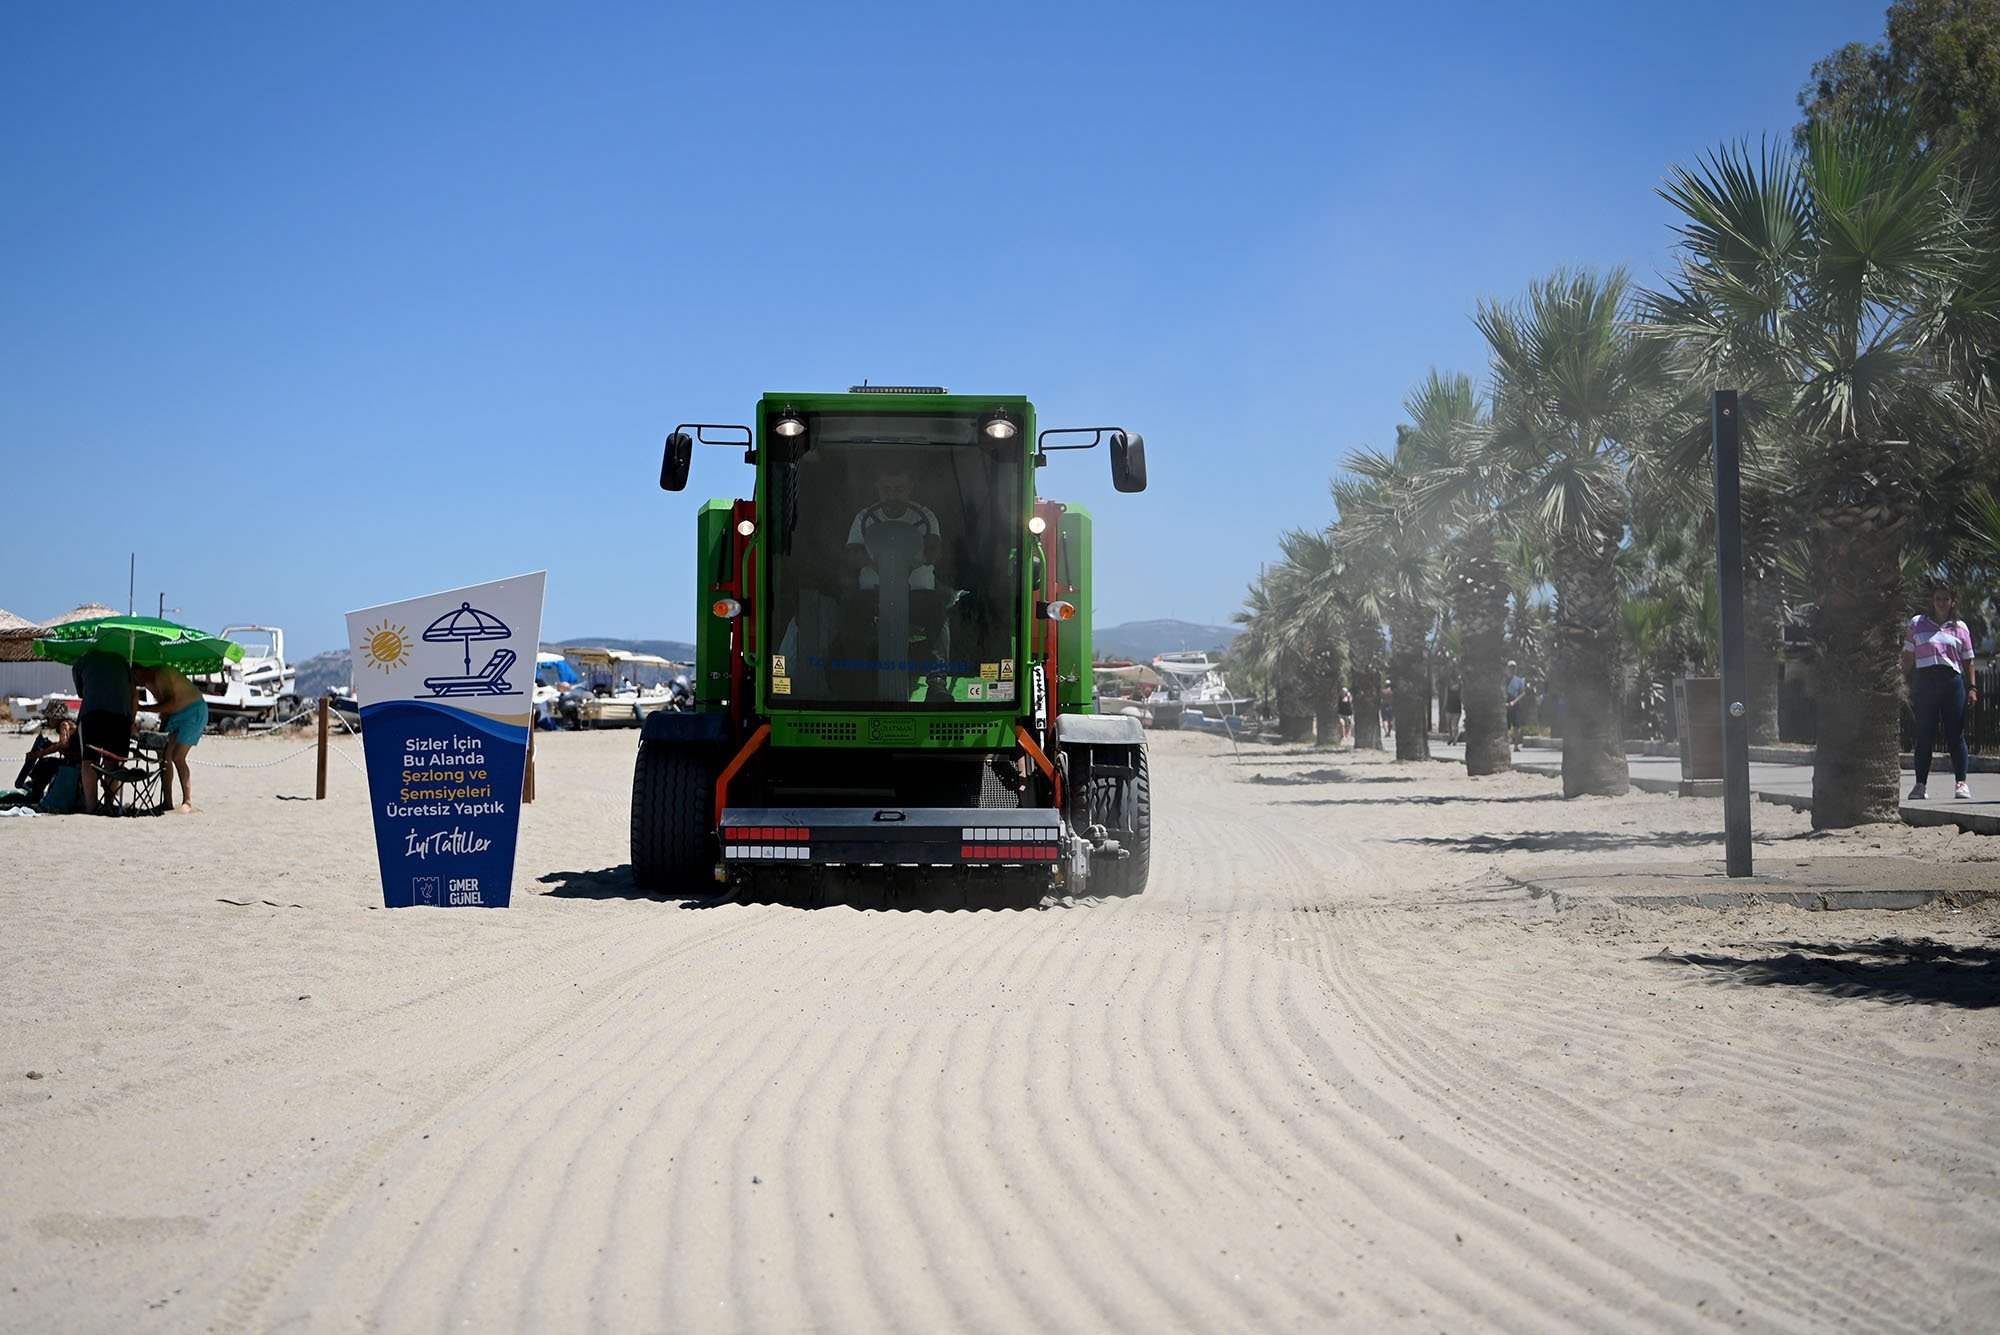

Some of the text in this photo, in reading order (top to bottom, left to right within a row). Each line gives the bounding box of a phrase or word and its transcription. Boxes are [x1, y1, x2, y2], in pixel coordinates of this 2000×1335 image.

[405, 733, 482, 753] Sizler İçin
[403, 751, 485, 767] Bu Alanda
[401, 768, 487, 786] Şezlong ve
[400, 784, 491, 804] Şemsiyeleri
[386, 800, 505, 818] Ücretsiz Yaptık
[405, 826, 492, 860] İyi Tatiller
[449, 878, 479, 892] ÖMER
[449, 892, 484, 905] GÜNEL
